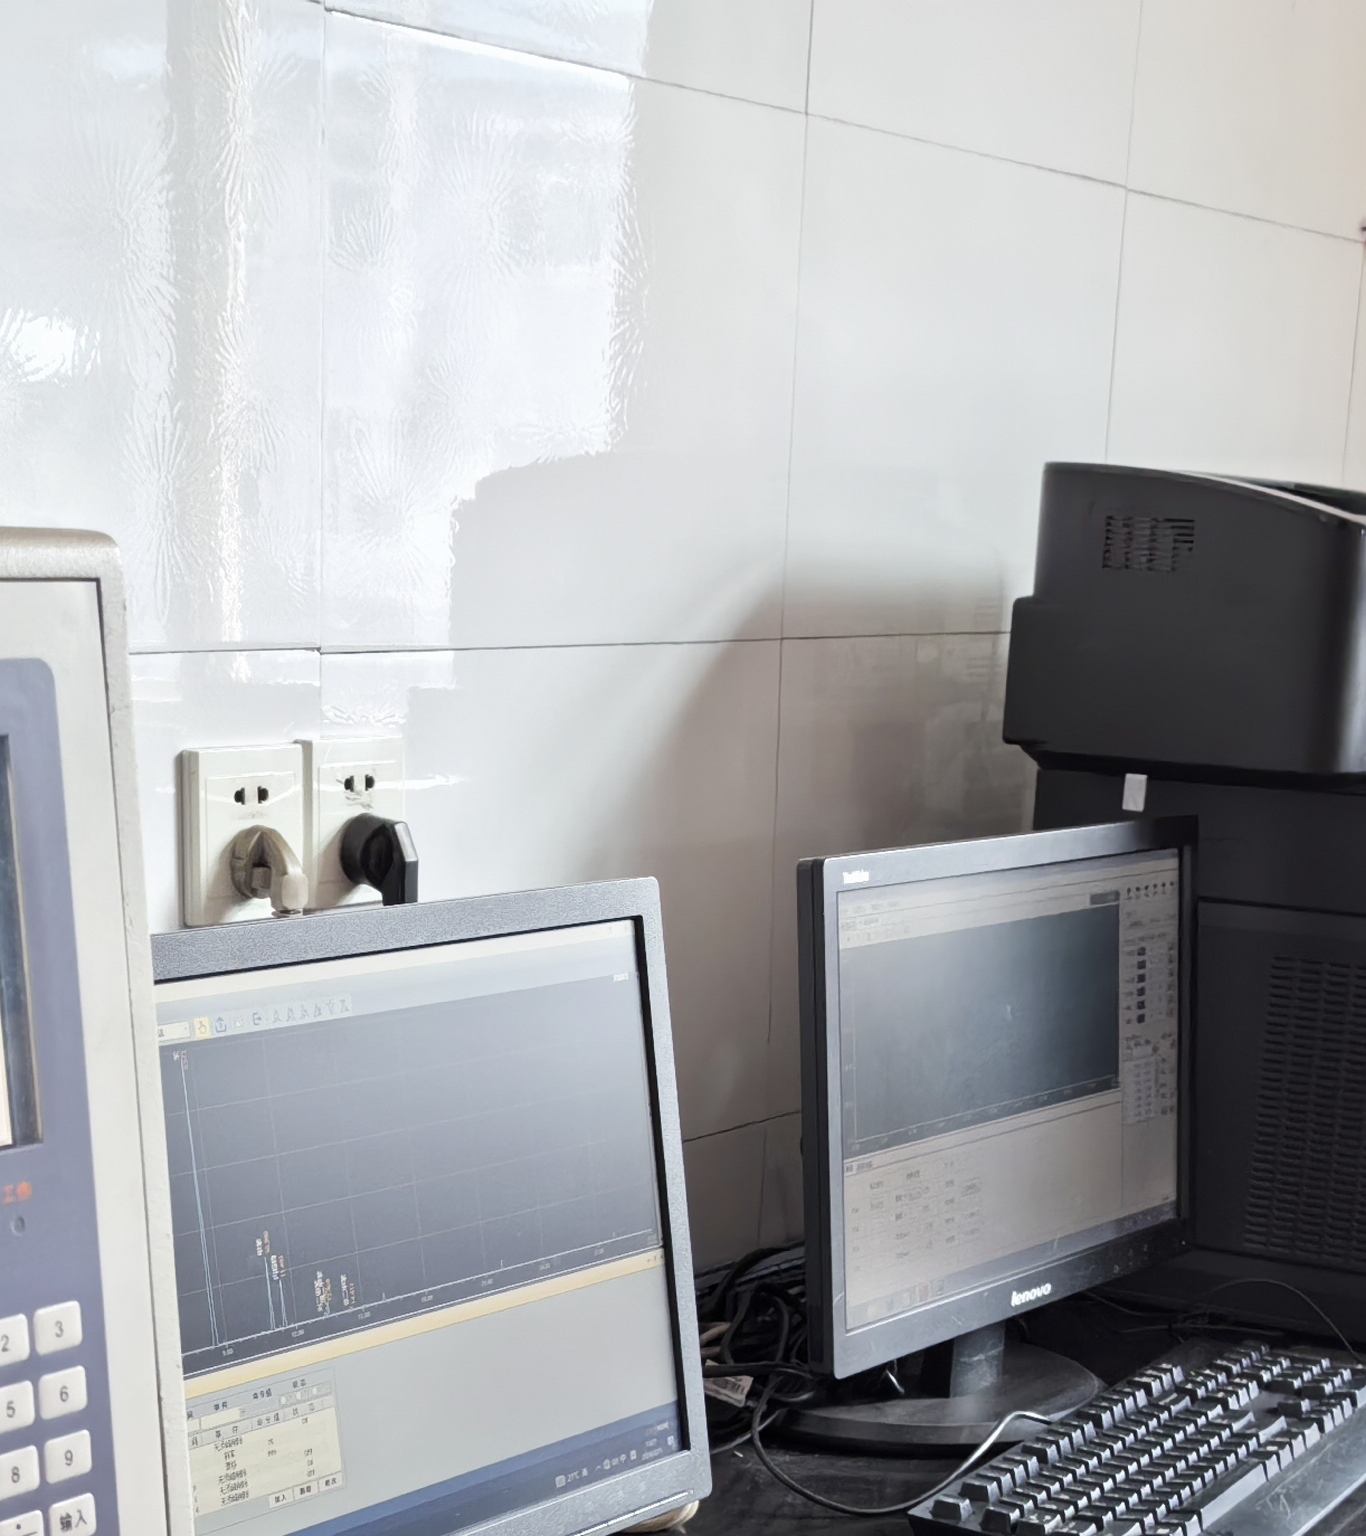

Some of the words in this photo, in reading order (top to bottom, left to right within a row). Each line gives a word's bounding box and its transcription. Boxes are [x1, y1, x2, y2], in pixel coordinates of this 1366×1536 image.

[54, 1320, 65, 1339] 3
[0, 1333, 10, 1353] 2
[59, 1384, 69, 1403] 6
[6, 1400, 17, 1419] 5
[64, 1448, 74, 1467] 9
[10, 1465, 21, 1484] 8
[59, 1509, 88, 1533] 输入
